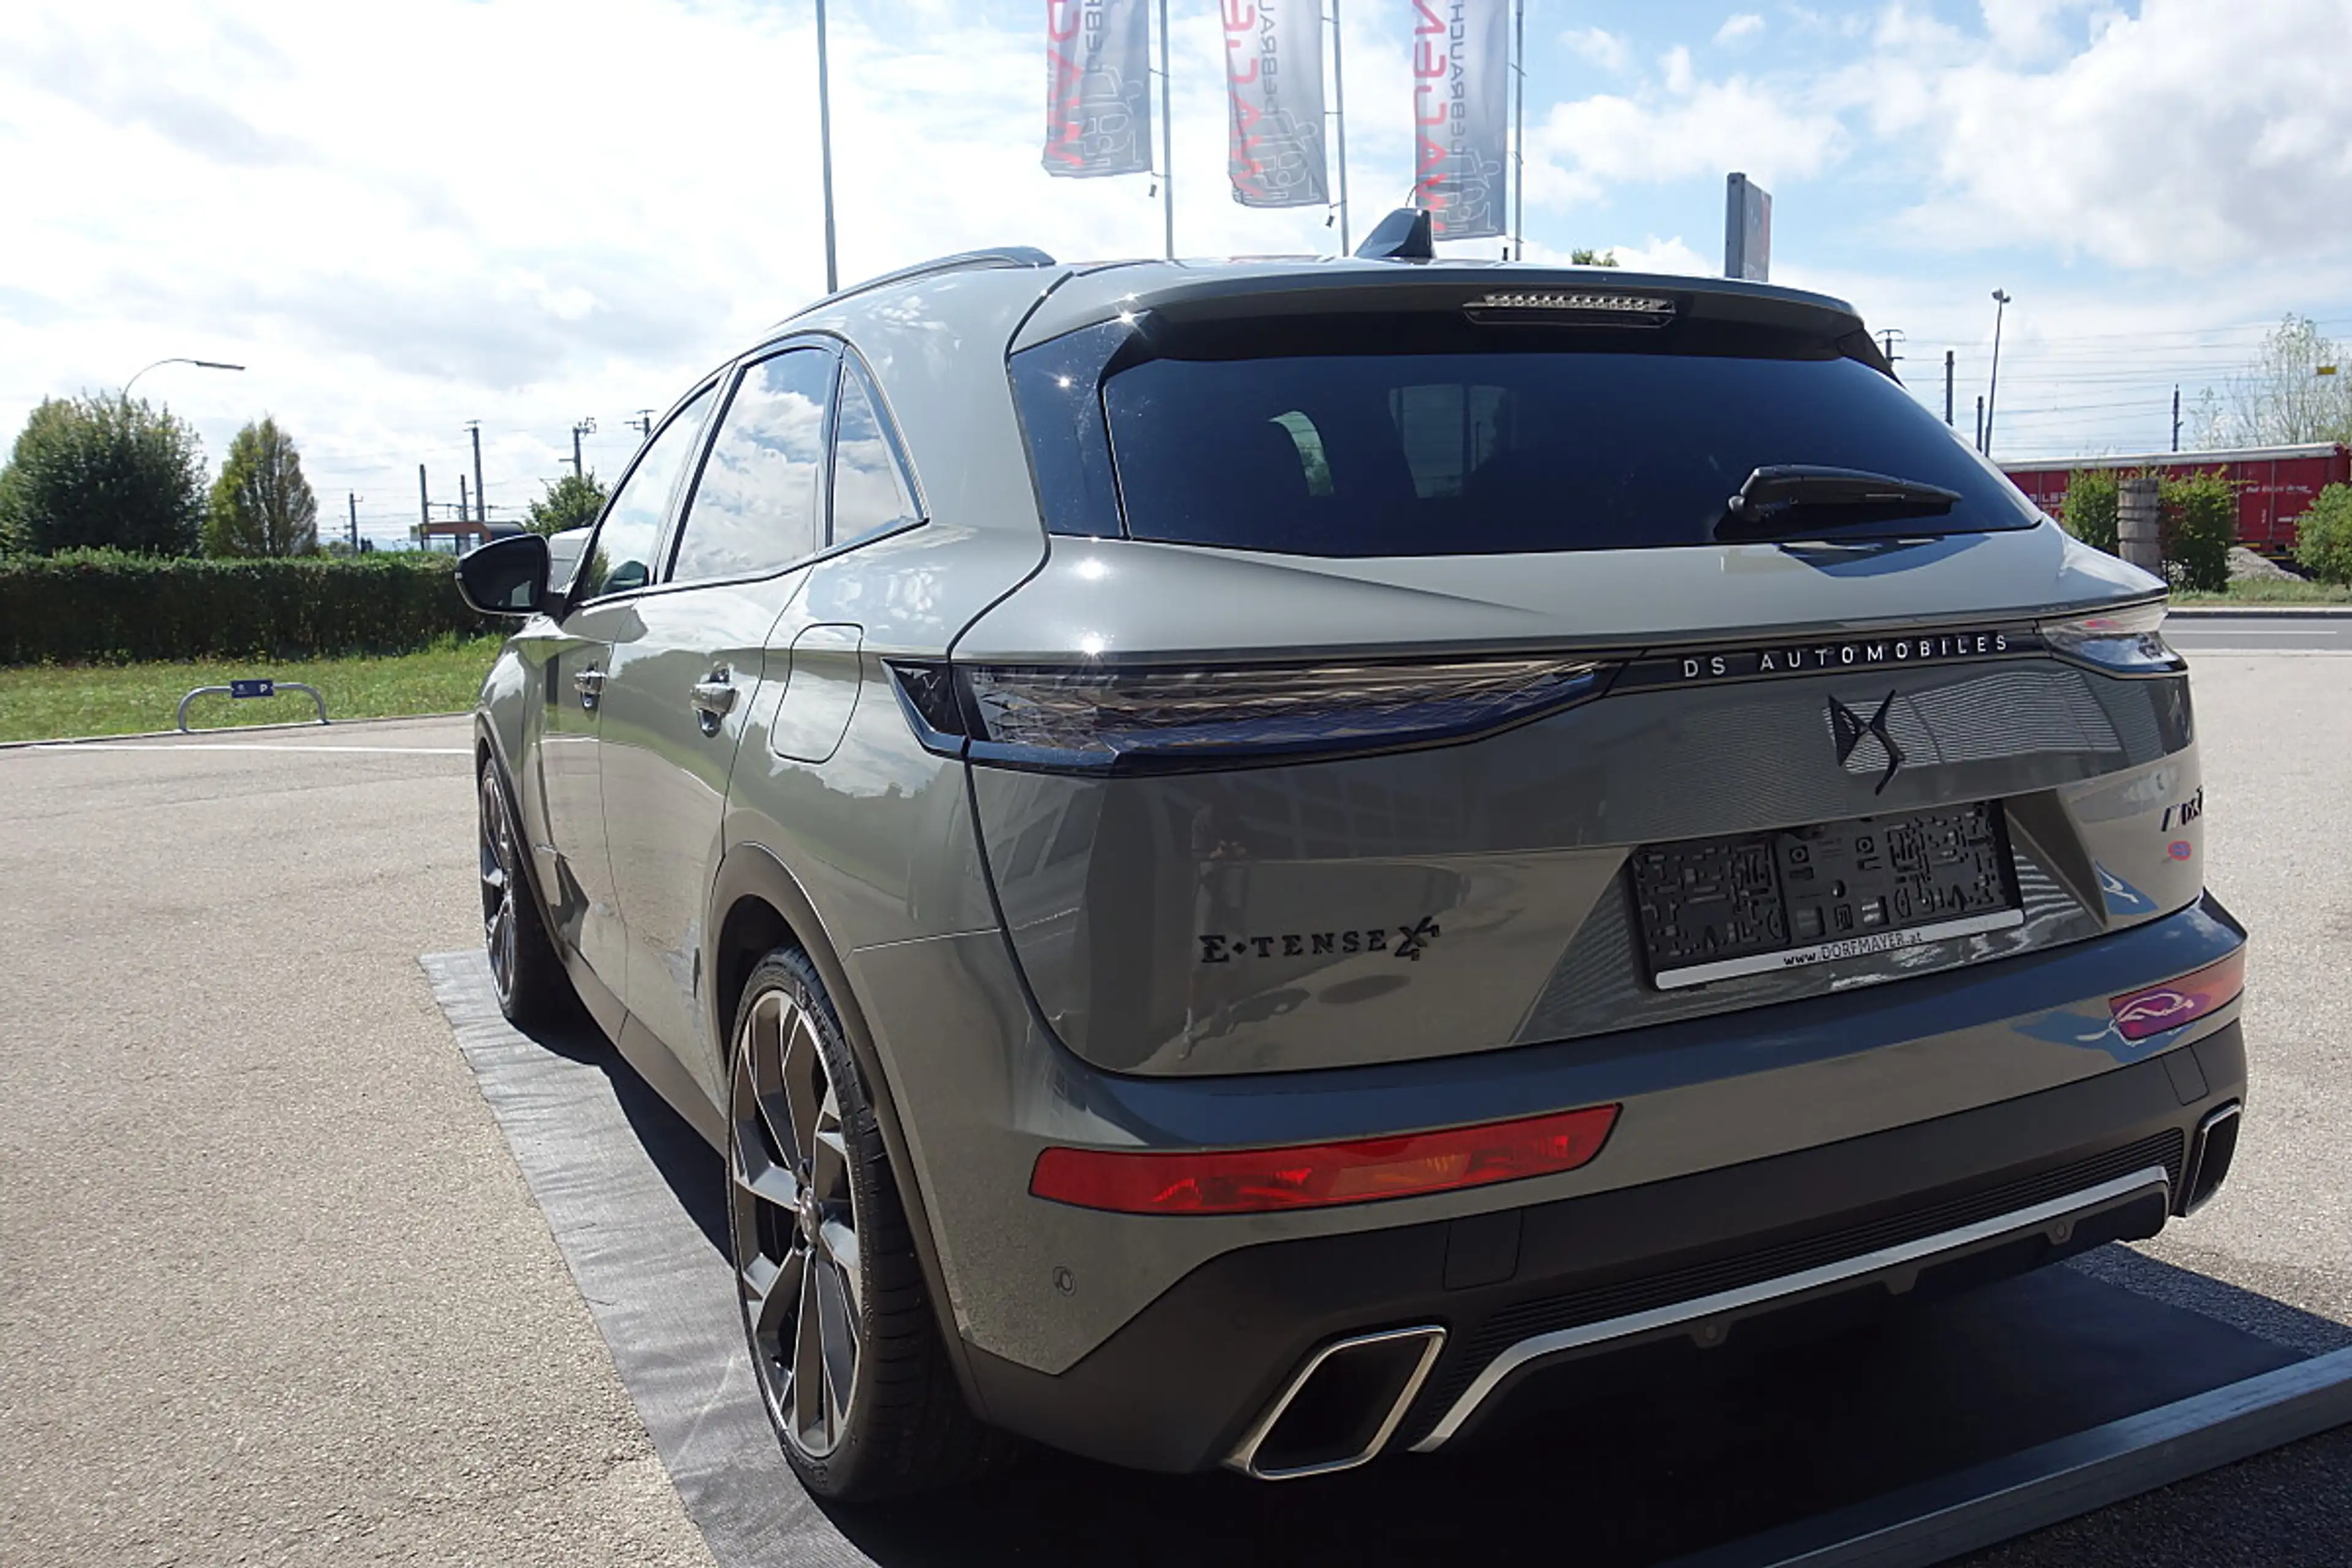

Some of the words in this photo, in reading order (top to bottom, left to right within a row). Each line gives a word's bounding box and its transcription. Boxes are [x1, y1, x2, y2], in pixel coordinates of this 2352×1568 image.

[1683, 656, 1726, 678] DS
[1759, 634, 2008, 671] AUTOMOBILES
[259, 683, 268, 693] P
[1783, 931, 1922, 966] www.DORFMAYER.at
